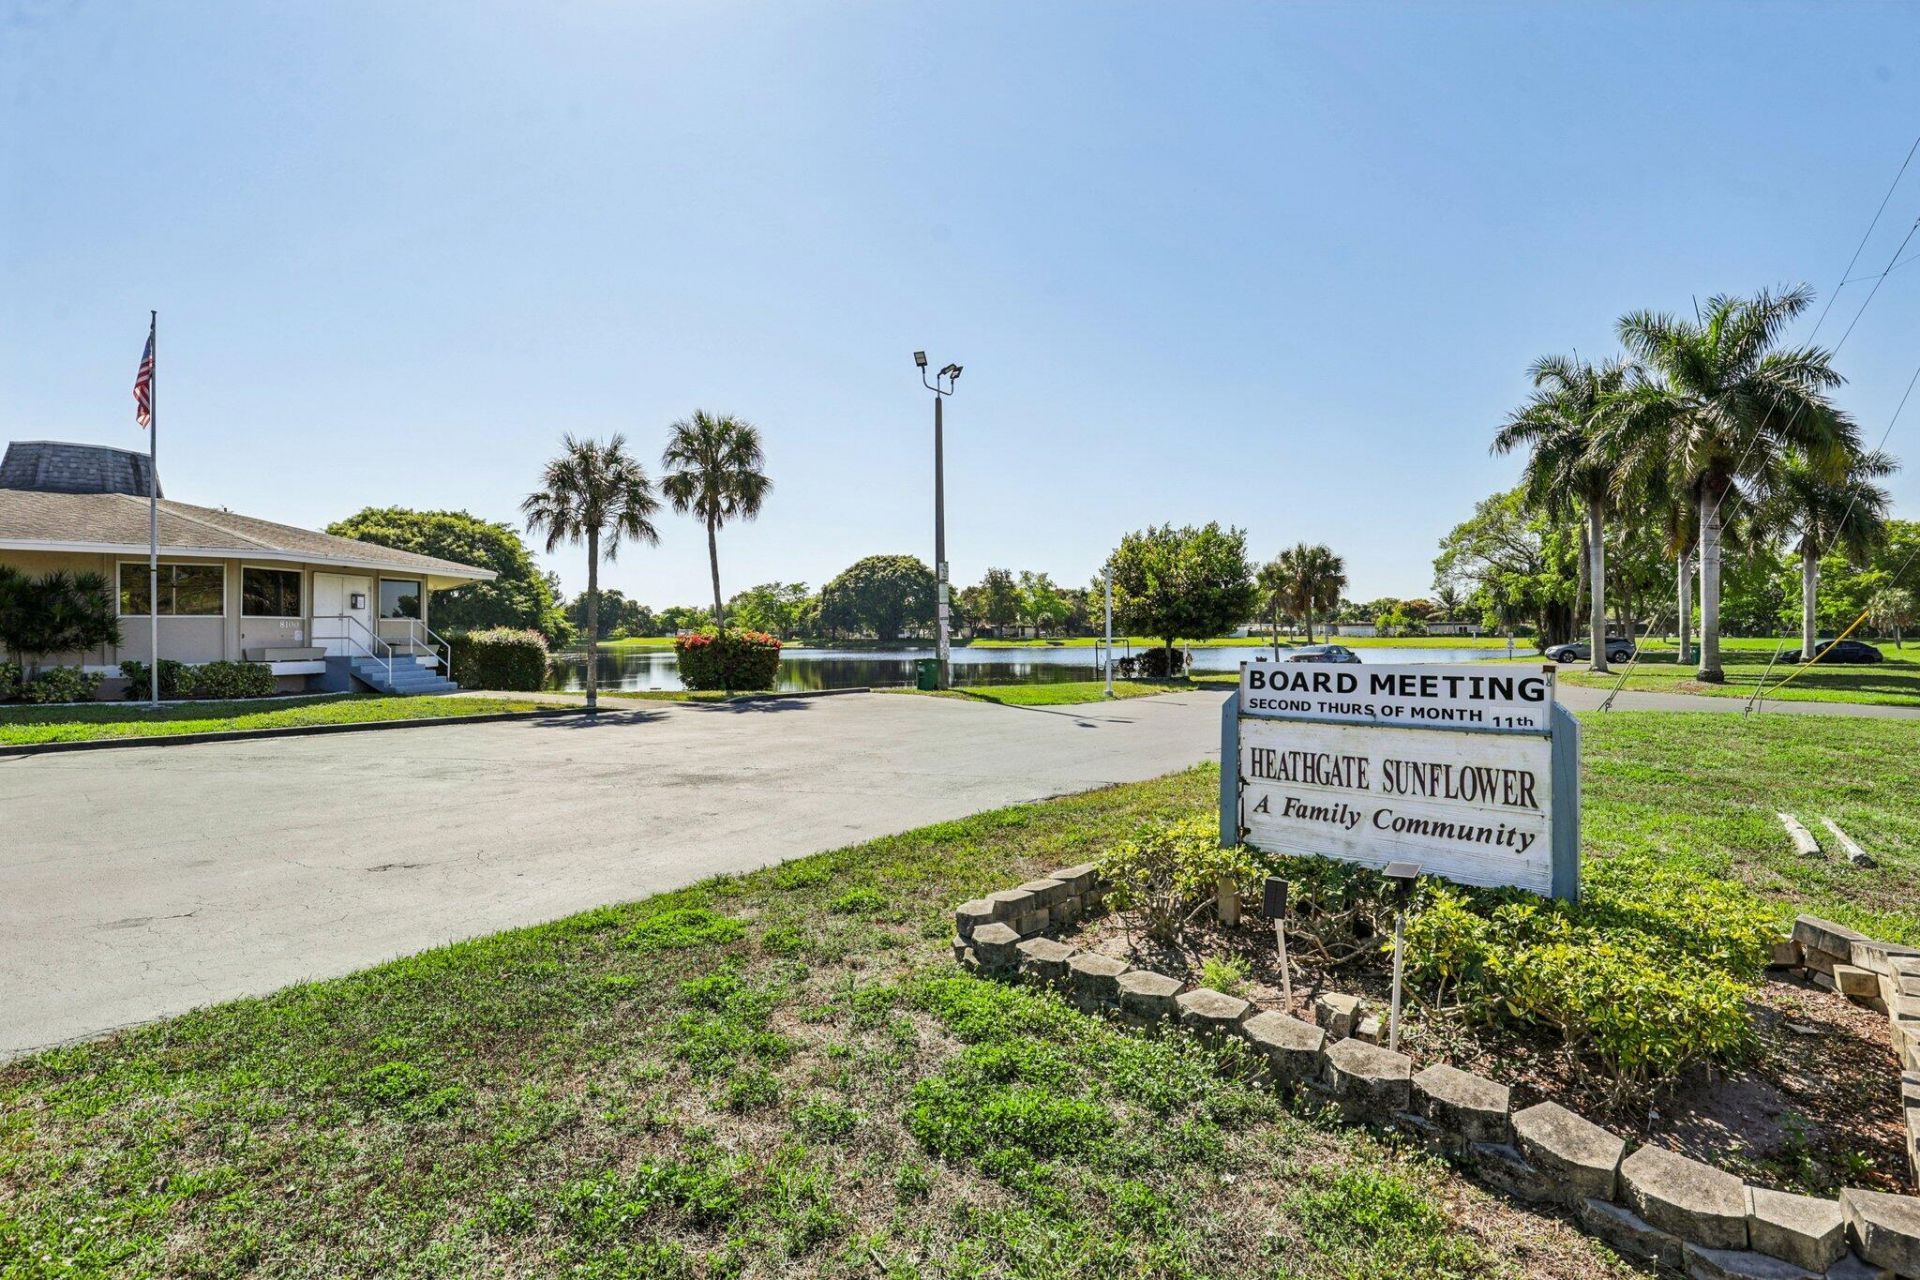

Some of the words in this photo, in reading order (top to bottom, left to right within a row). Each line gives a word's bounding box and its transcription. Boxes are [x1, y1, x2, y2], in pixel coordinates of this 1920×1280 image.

[1249, 670, 1358, 694] BOARD
[1370, 673, 1545, 702] MEETING
[1249, 697, 1312, 712] SECOND
[1319, 701, 1375, 716] THURS
[1381, 704, 1404, 718] OF
[1411, 706, 1482, 722] MONTH
[1492, 715, 1534, 729] 11th
[1250, 747, 1370, 790] HEATHGATE
[1382, 758, 1539, 809] SUNFLOWER
[1253, 794, 1270, 814] A
[1281, 796, 1362, 831] Family
[1373, 808, 1535, 854] Community
